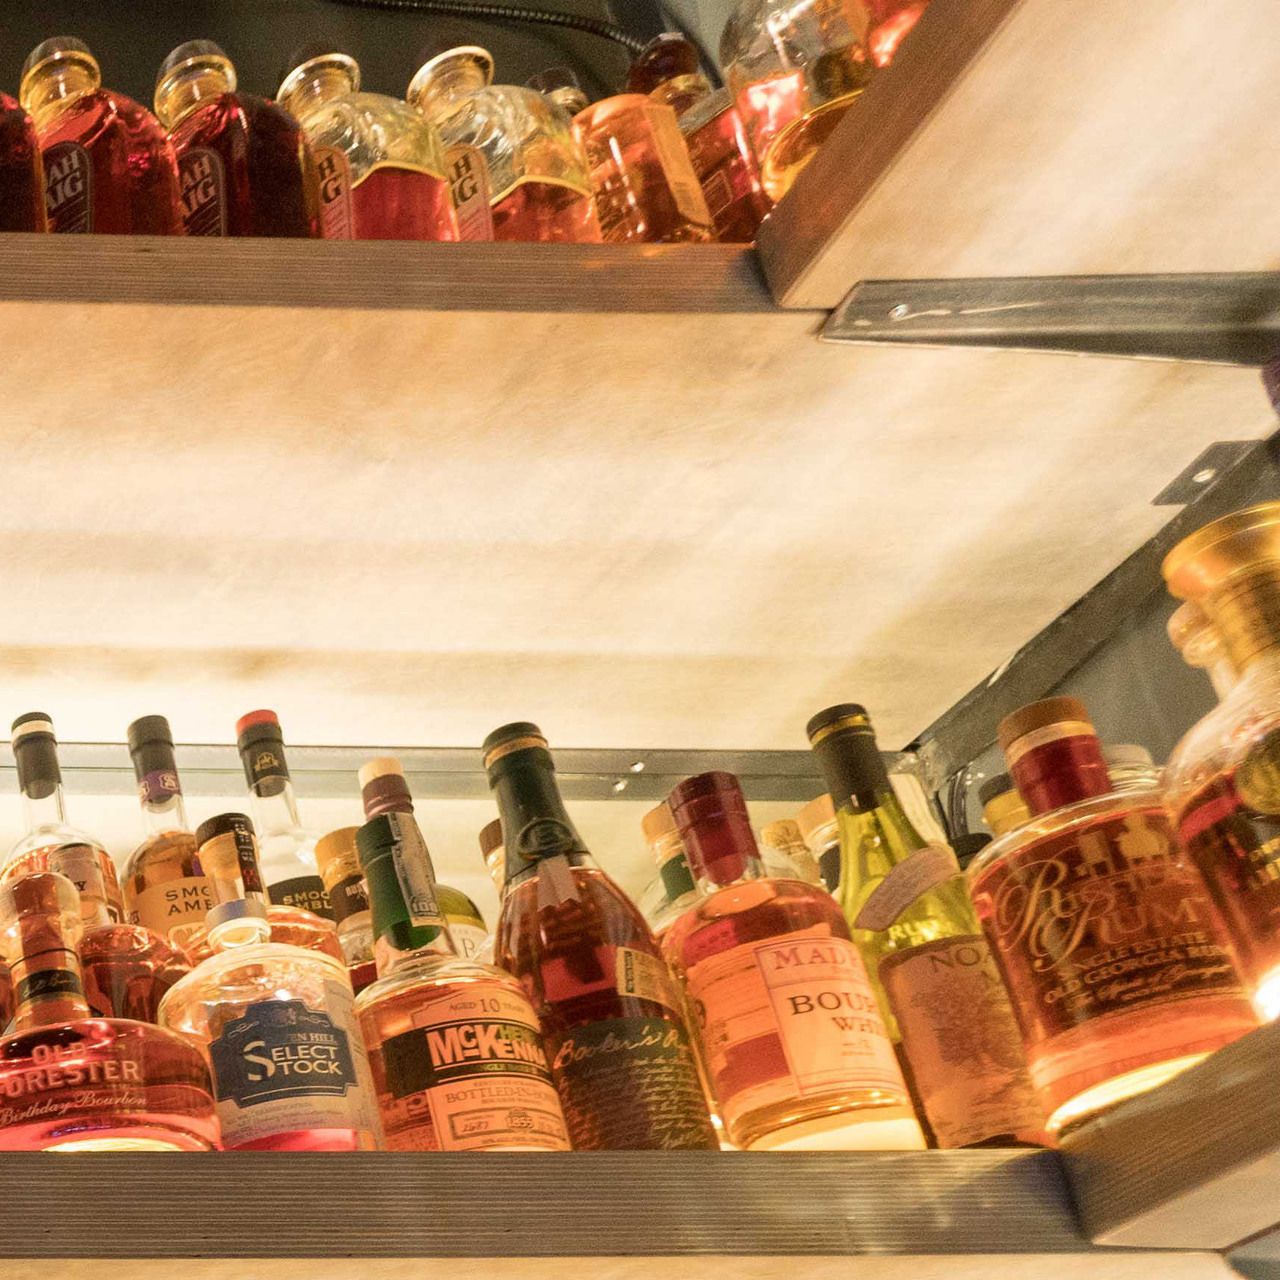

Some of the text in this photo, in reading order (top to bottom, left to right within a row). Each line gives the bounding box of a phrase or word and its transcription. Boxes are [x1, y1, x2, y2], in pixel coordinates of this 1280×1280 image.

[480, 998, 500, 1013] 10
[31, 1042, 86, 1065] OLD
[74, 1089, 147, 1108] Bourbon
